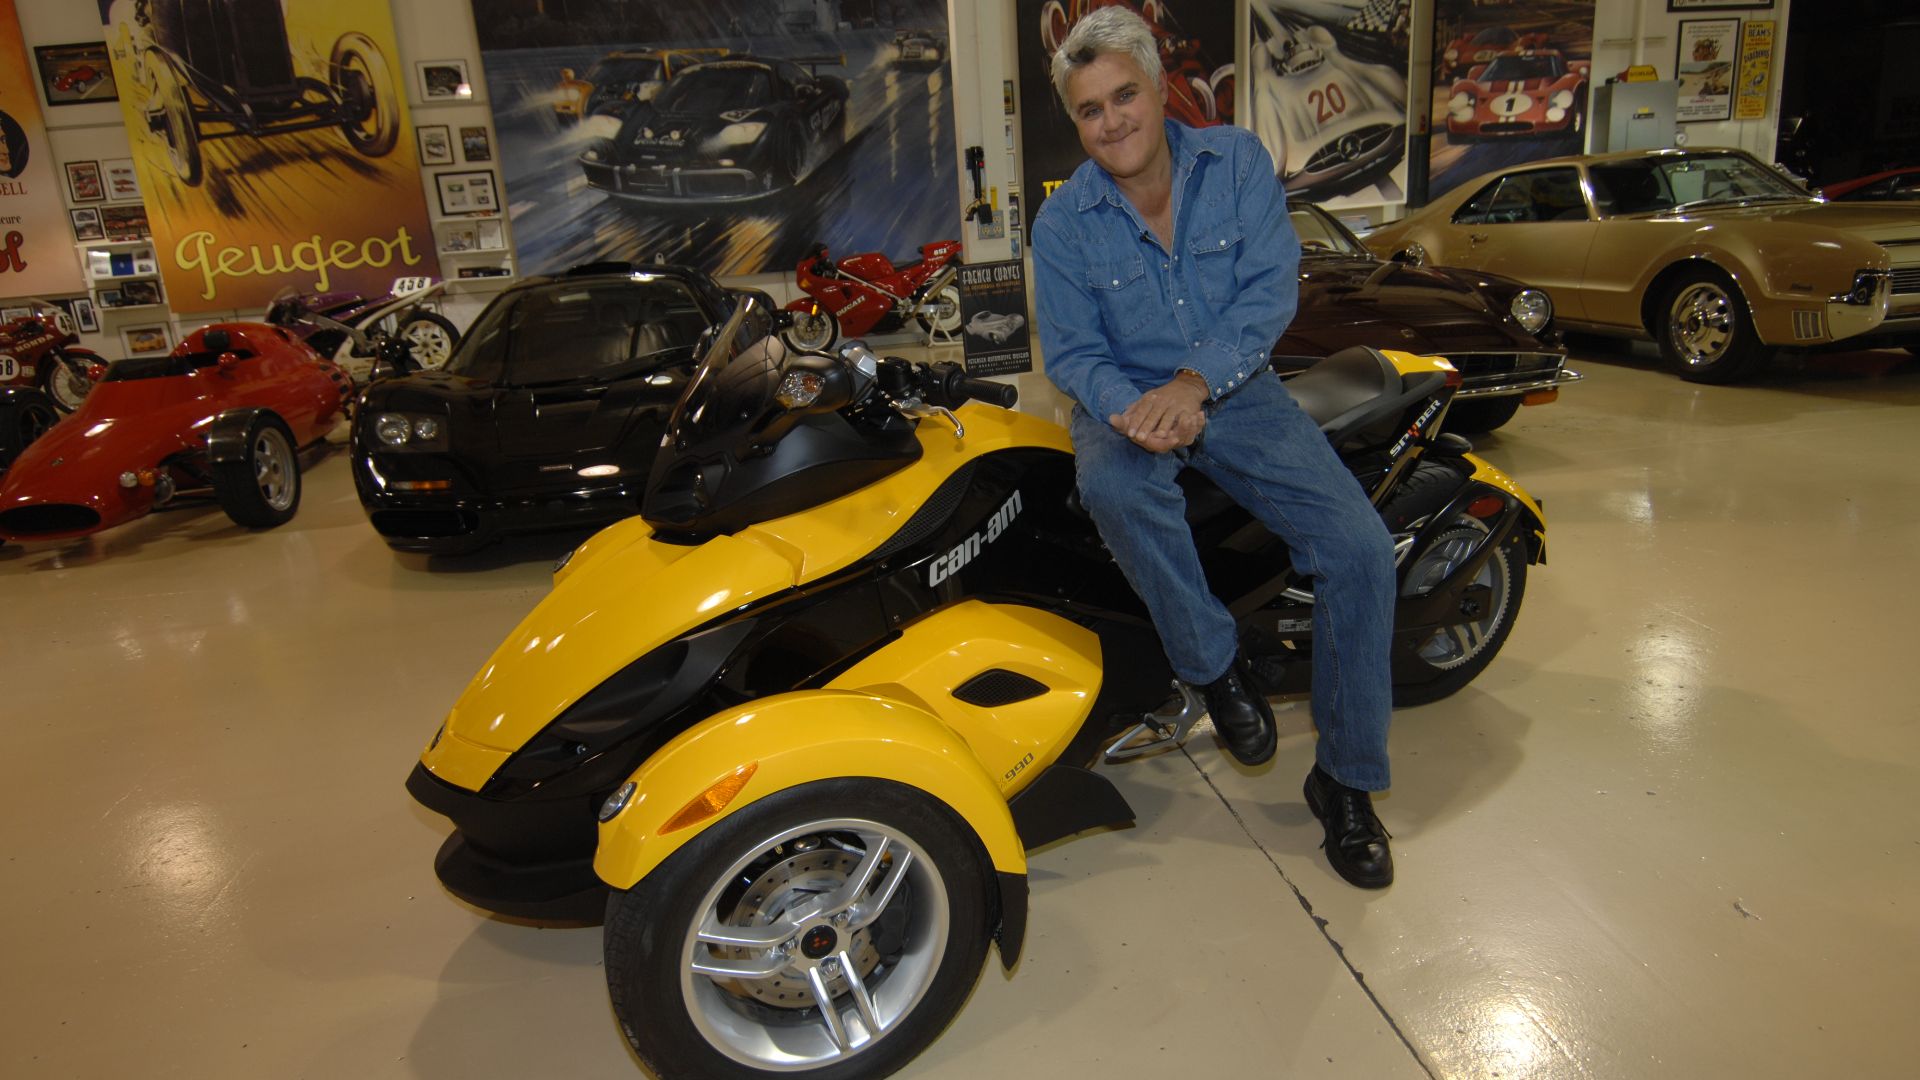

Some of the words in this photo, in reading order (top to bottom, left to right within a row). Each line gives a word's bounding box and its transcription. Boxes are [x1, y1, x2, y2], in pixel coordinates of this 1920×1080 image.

[1308, 82, 1347, 124] 20
[1505, 97, 1516, 112] 1
[0, 182, 28, 195] ELL
[175, 226, 421, 300] Peugeot
[962, 267, 991, 285] FRENCH
[993, 265, 1020, 282] CURVES
[836, 295, 866, 317] DUCATI
[15, 334, 55, 352] HONDA
[1390, 399, 1441, 457] SPYDER
[1004, 752, 1034, 782] 990
